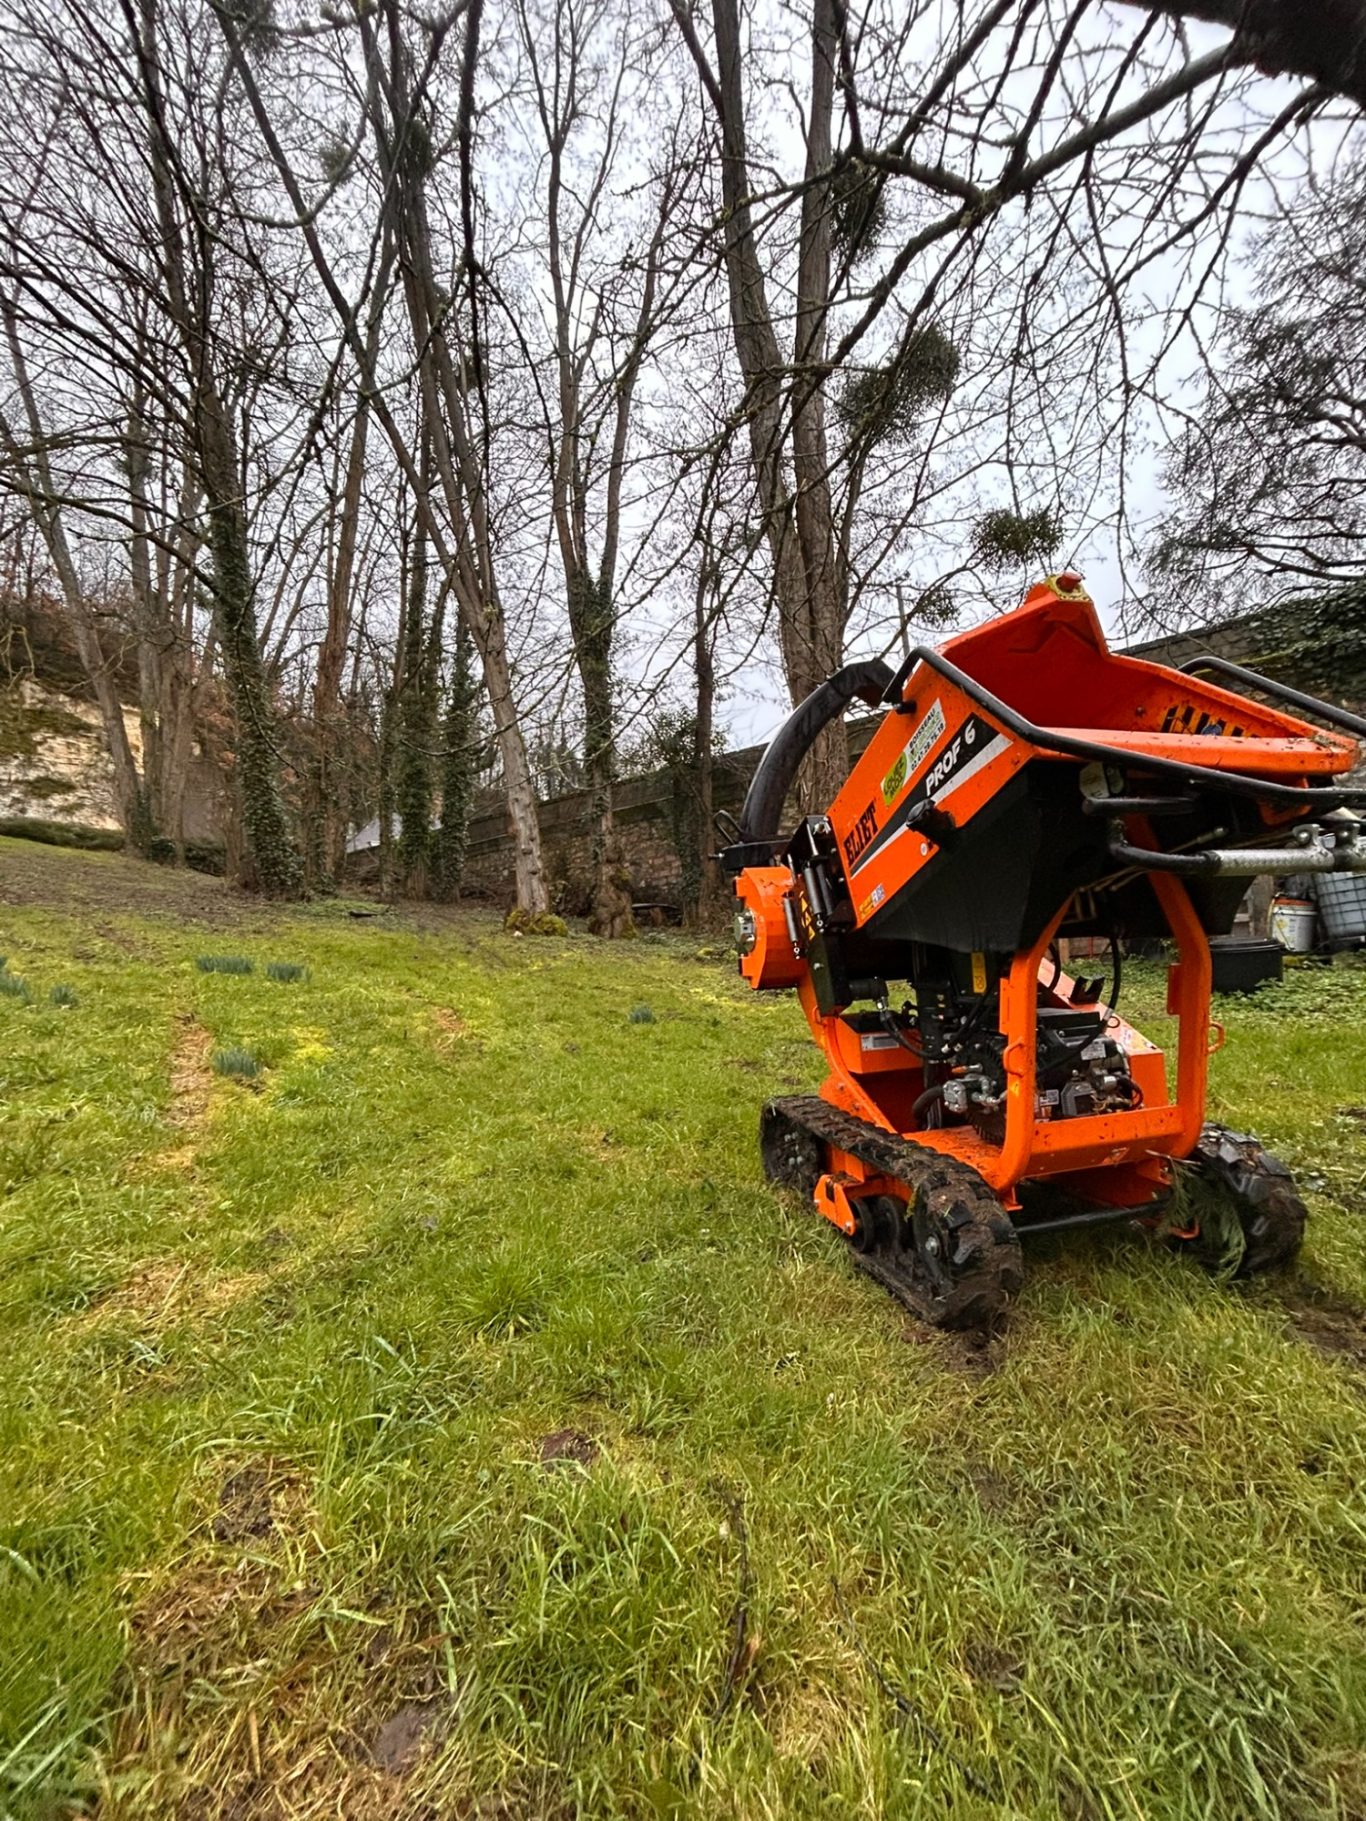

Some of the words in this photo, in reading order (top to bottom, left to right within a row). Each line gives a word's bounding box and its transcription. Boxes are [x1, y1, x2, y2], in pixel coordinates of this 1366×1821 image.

[909, 708, 935, 748] BOISSEAU
[925, 737, 961, 796] PROF
[965, 720, 977, 746] 6
[844, 800, 879, 867] ELIET
